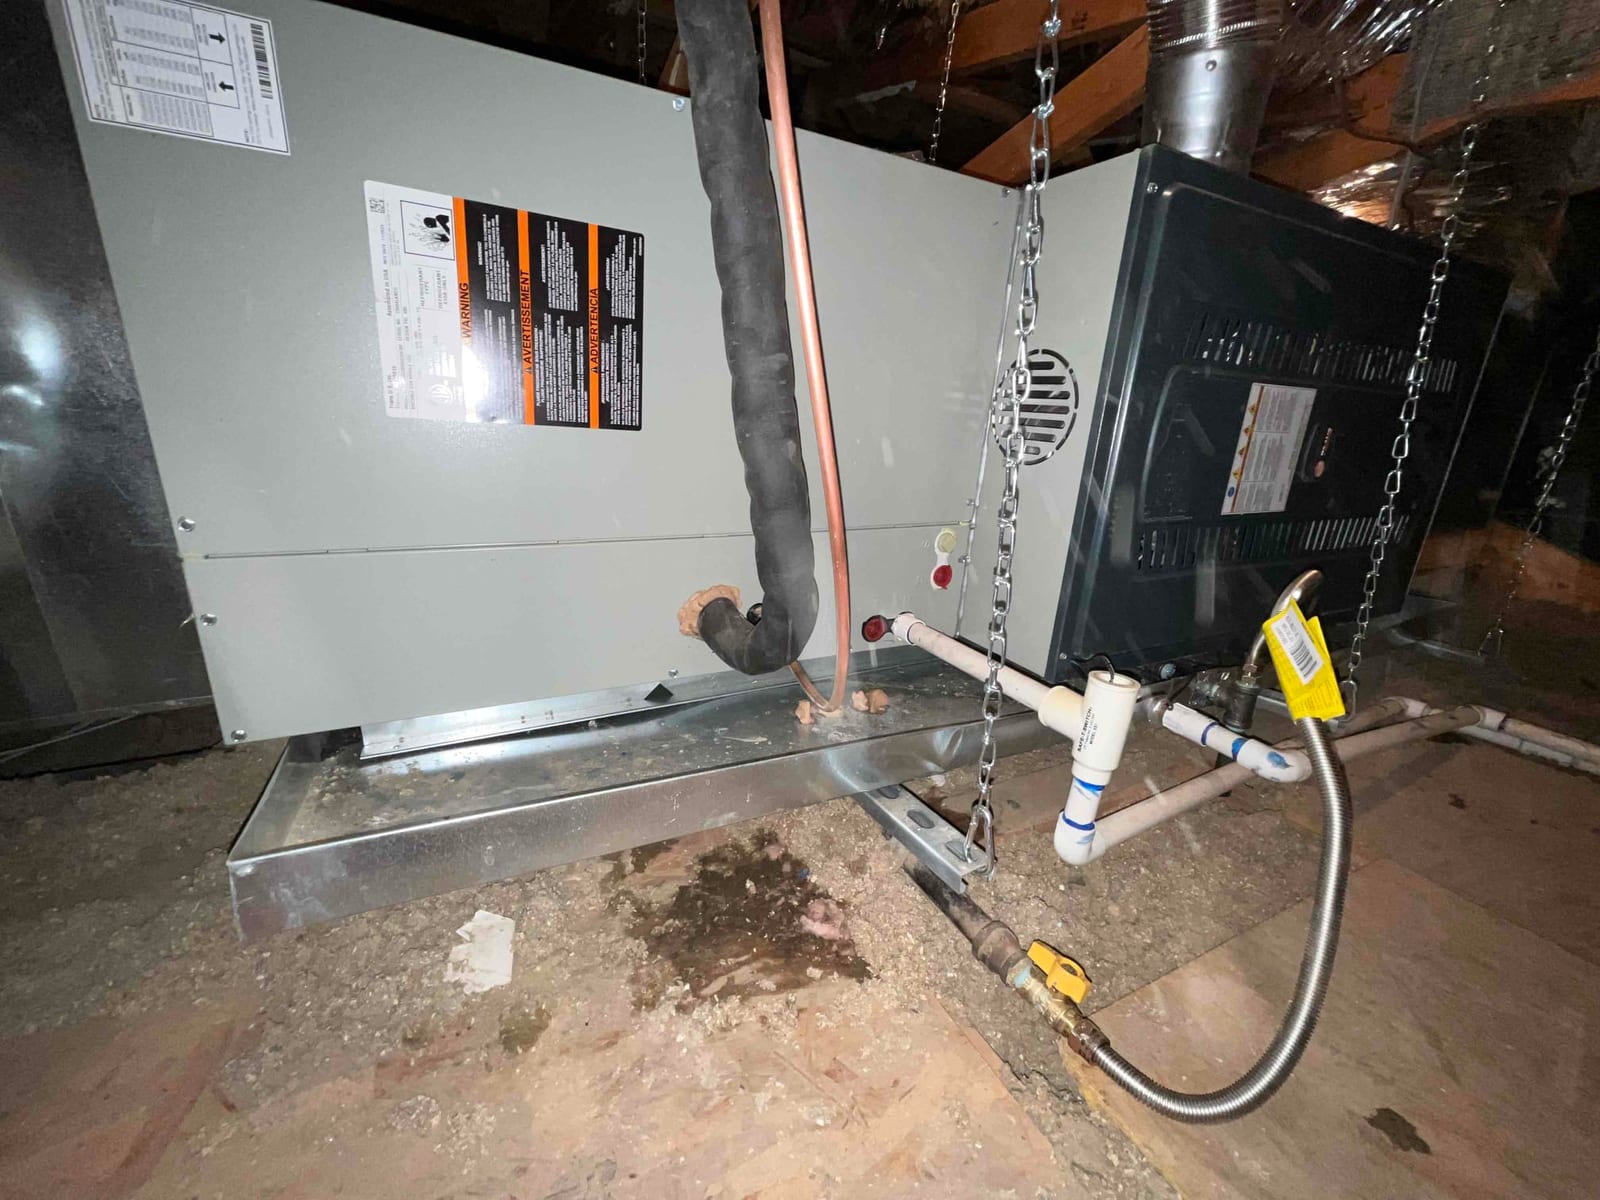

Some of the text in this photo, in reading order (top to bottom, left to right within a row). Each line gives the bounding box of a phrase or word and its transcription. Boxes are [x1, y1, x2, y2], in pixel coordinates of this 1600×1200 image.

[460, 282, 472, 339] WARNING
[520, 269, 532, 364] AVERTISSEMENT
[590, 287, 599, 363] ADVERTENCIA
